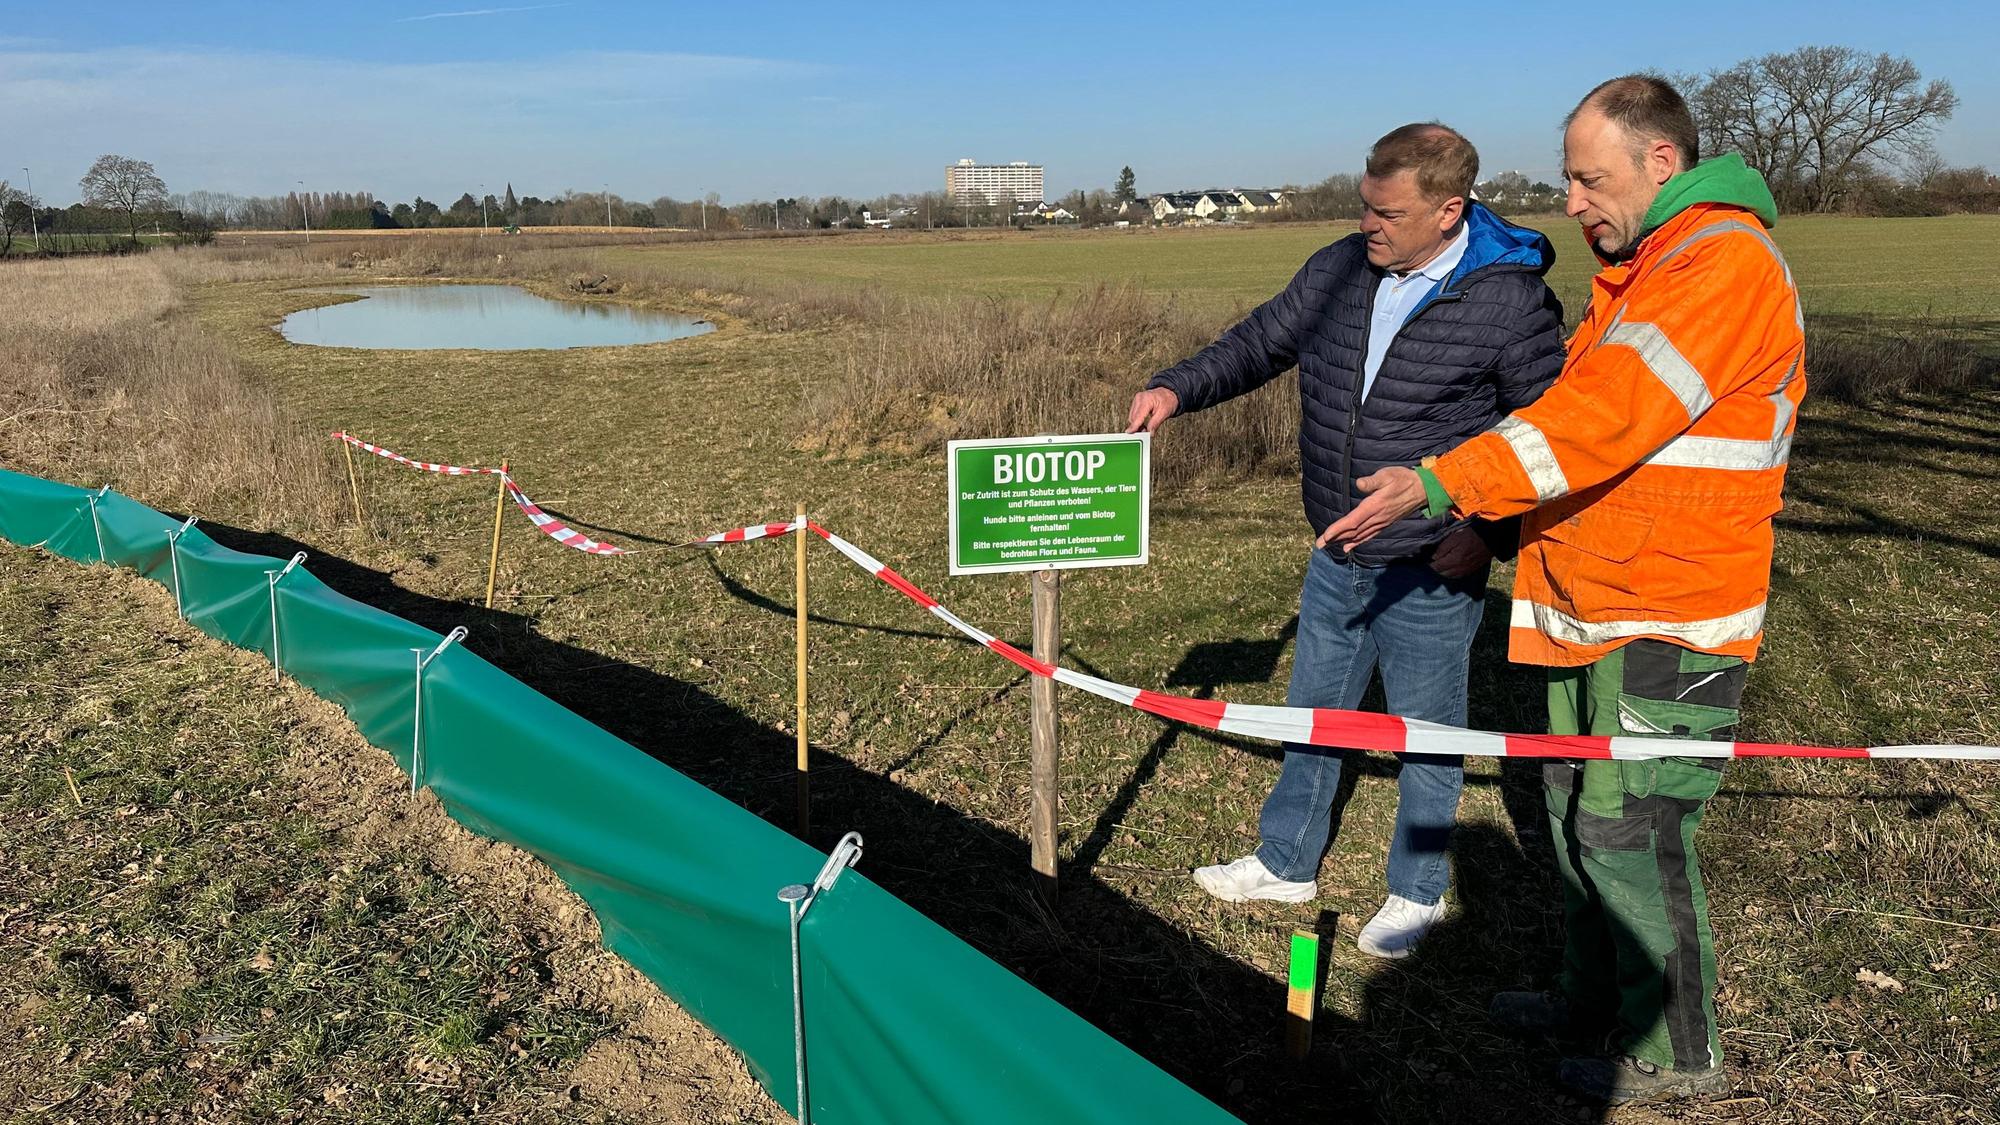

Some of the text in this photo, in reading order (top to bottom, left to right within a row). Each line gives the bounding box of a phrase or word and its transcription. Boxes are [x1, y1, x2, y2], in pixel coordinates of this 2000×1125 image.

[993, 450, 1105, 484] BIOTOP
[962, 492, 974, 500] Der
[976, 490, 1000, 499] Zutritt
[1030, 488, 1055, 496] Schutz
[1056, 487, 1069, 495] des
[1071, 486, 1103, 495] Wassers,
[1105, 485, 1117, 493] der
[1118, 484, 1136, 492] Tiere
[1008, 497, 1091, 508] und Pflanzen verboten!
[984, 515, 1007, 524] Hunde
[1009, 515, 1025, 523] bitte
[1027, 513, 1058, 522] anleinen
[1059, 513, 1074, 521] und
[1092, 511, 1115, 520] Biotop
[1030, 523, 1069, 532] fernhalten!
[973, 534, 1125, 550] Bitte respektieren Sie den Lebensraum der
[1001, 549, 1037, 558] bedrohten
[1039, 548, 1057, 556] Flora
[1074, 546, 1098, 554] Fauna.
